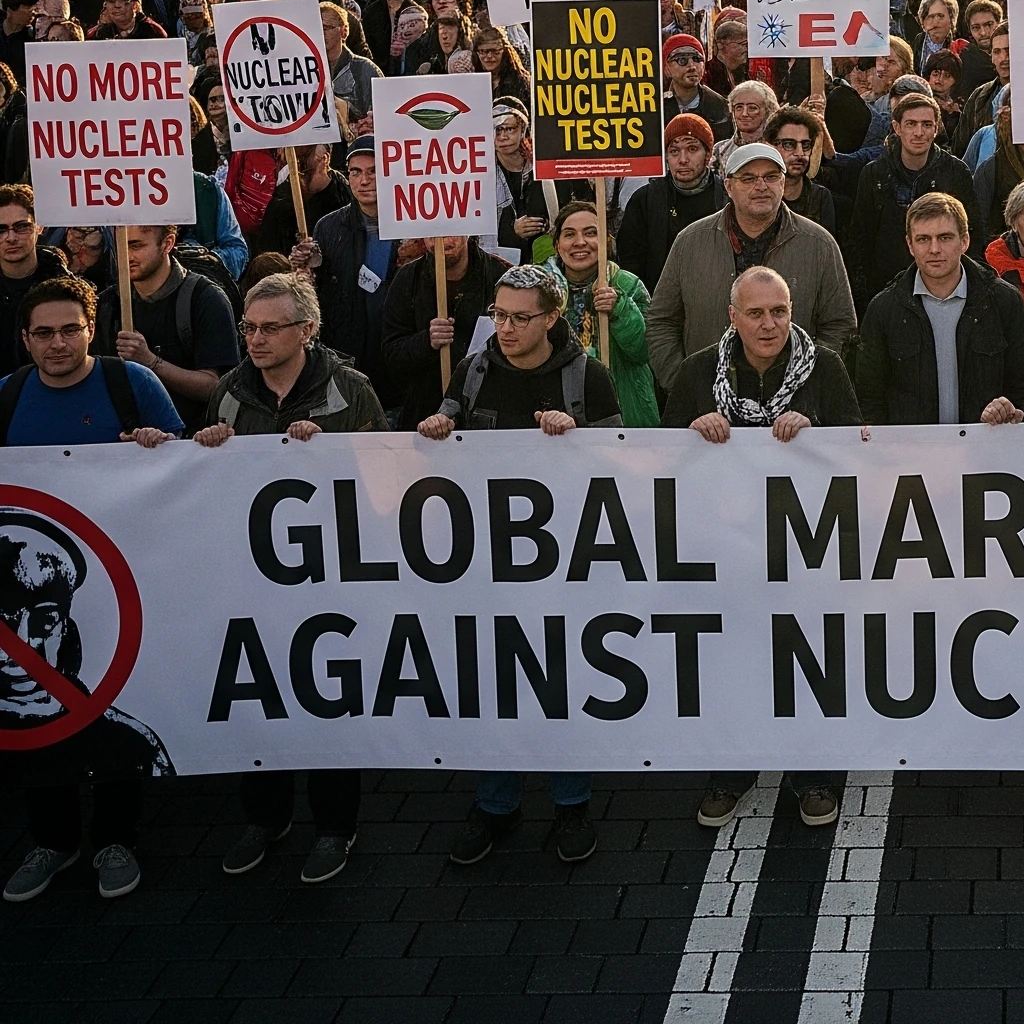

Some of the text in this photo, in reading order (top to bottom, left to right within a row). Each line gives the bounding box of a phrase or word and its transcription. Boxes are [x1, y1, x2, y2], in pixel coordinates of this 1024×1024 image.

[569, 7, 617, 44] NO
[32, 62, 184, 102] NO MORE
[225, 56, 320, 90] NUCLEAR
[536, 48, 654, 81] NUCLEAR
[537, 82, 656, 116] NUCLEAR
[33, 119, 183, 158] NUCLEAR
[558, 118, 645, 152] TESTS
[382, 136, 487, 176] PEACE
[61, 169, 168, 206] TESTS
[394, 181, 481, 221] NOW!
[249, 477, 717, 585] GLOBAL
[207, 613, 722, 722] AGAINST
